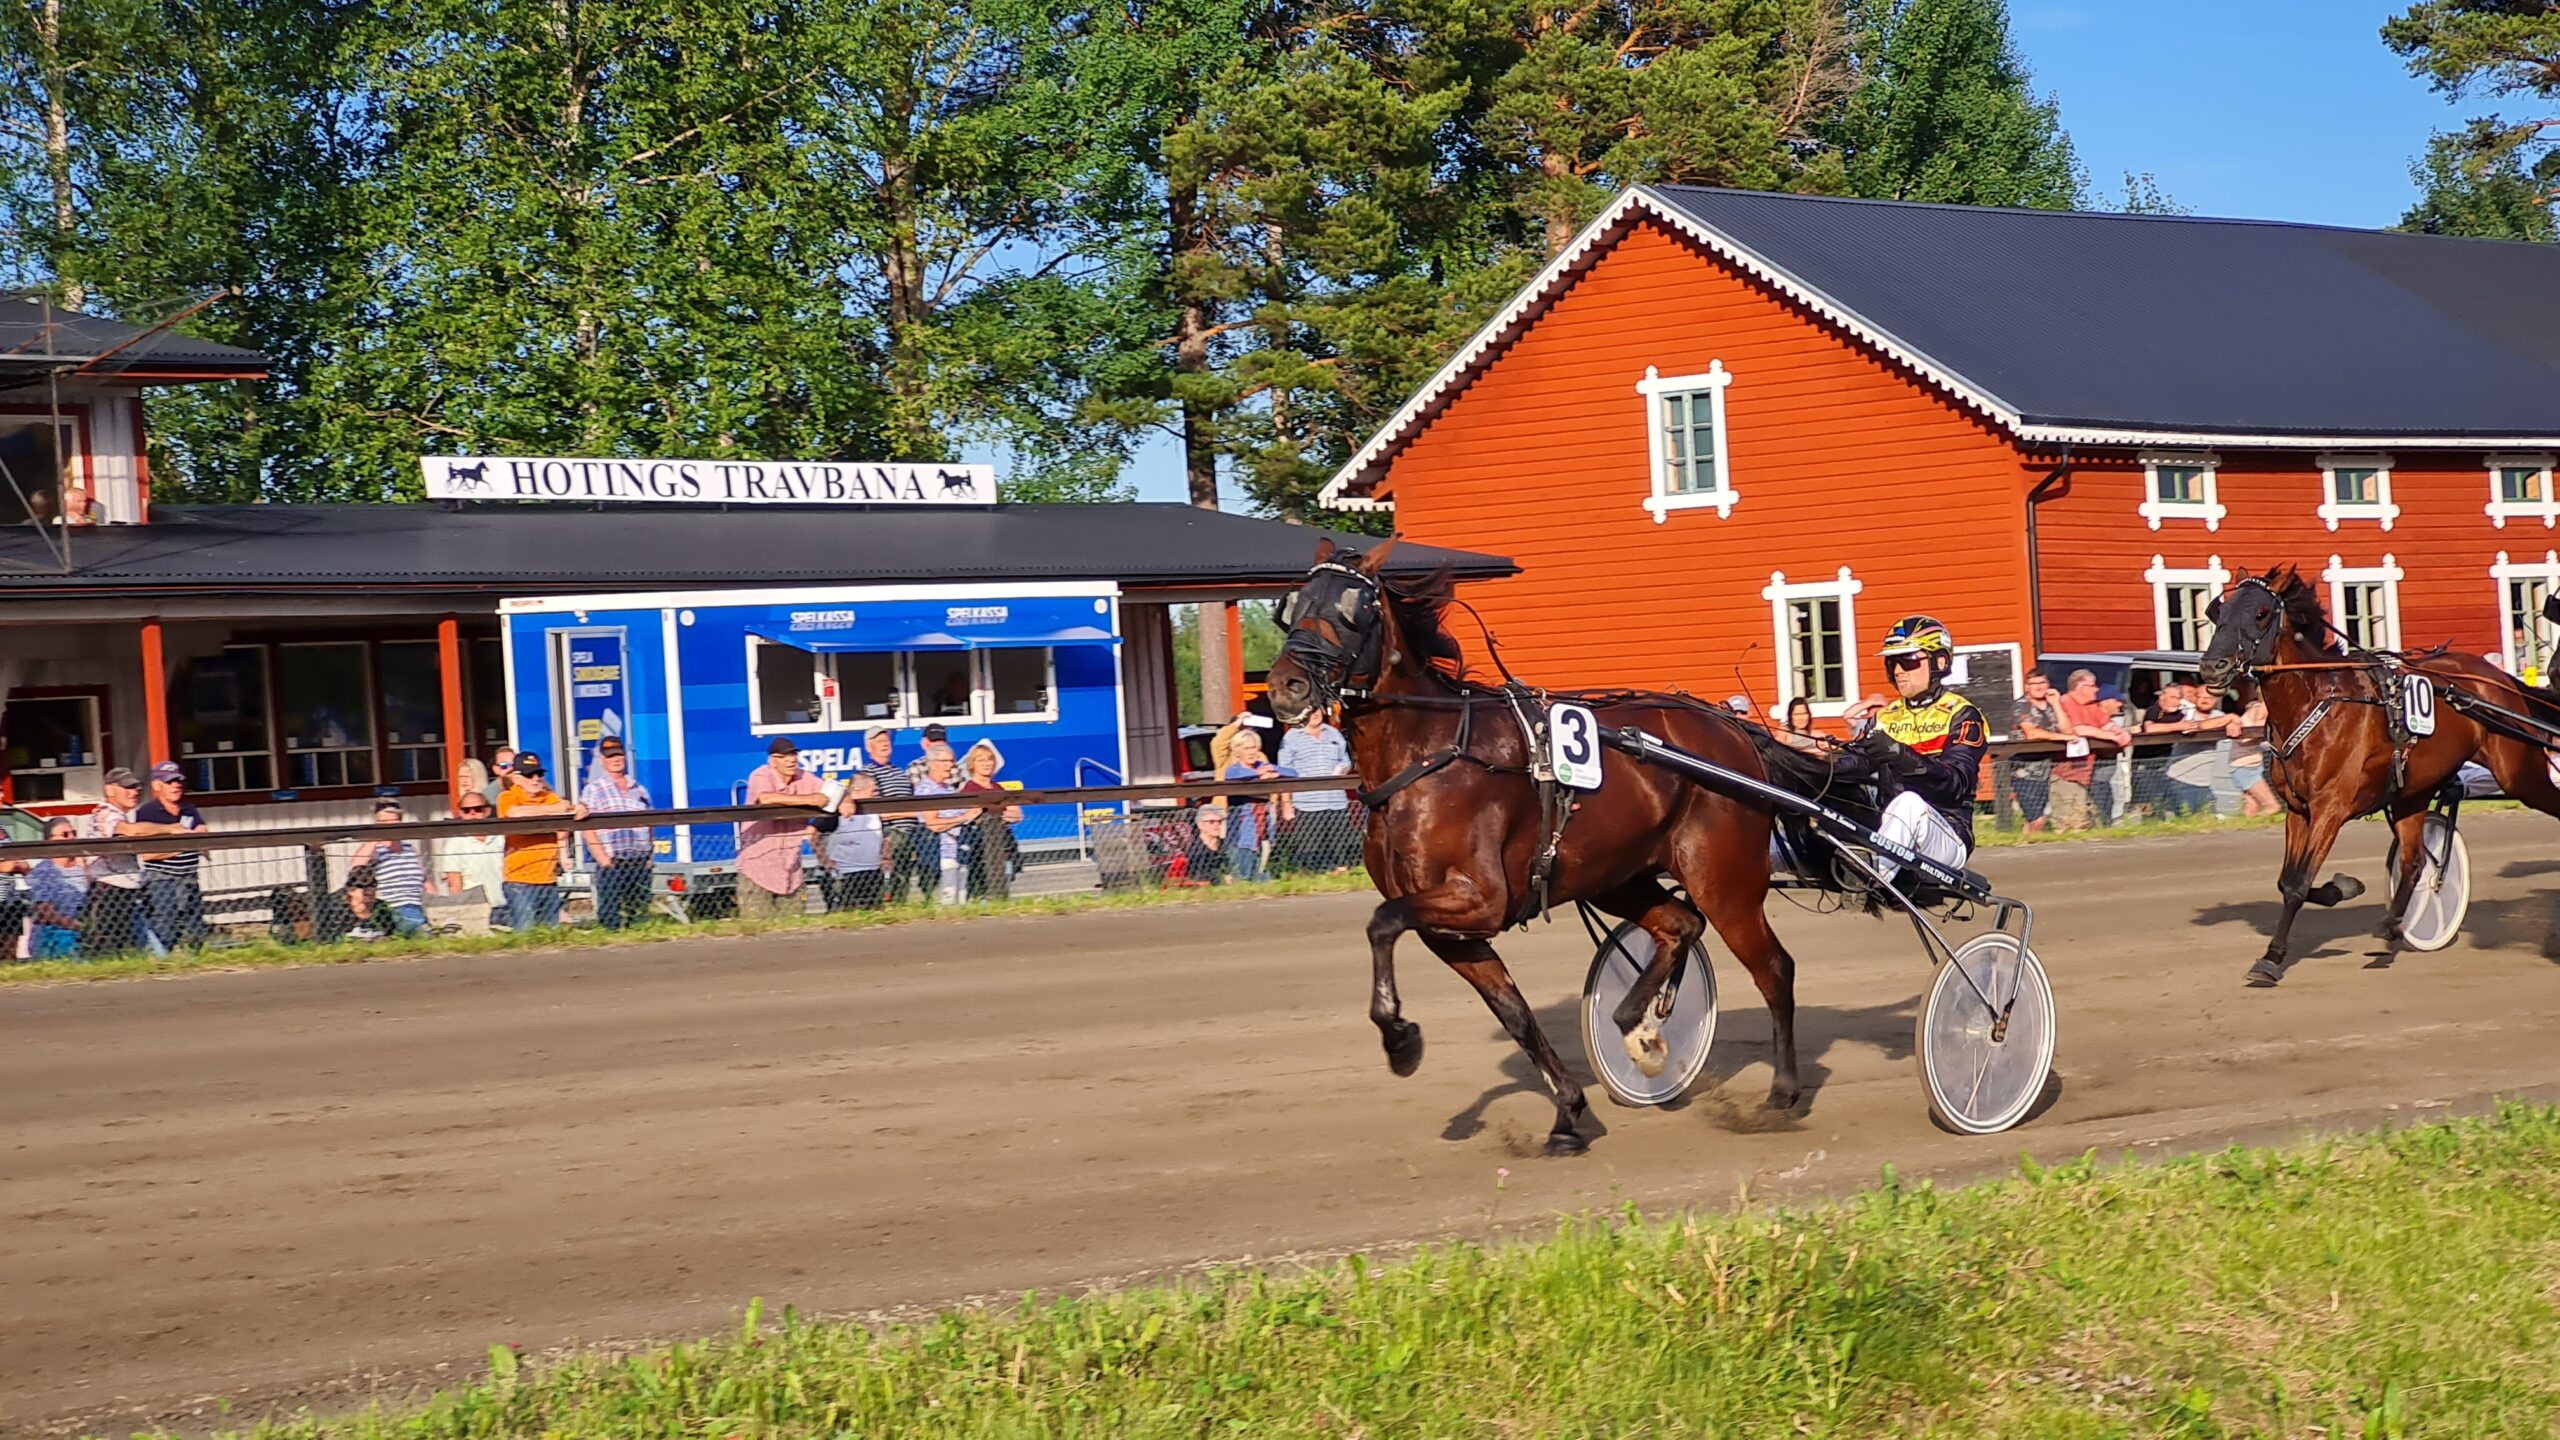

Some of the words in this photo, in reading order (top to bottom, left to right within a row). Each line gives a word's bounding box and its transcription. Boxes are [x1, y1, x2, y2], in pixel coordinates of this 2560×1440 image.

[508, 461, 701, 498] HOTINGS
[714, 465, 927, 500] TRAVBANA
[790, 610, 855, 623] SPELKASSA
[946, 606, 1008, 618] SPELKASSA
[2404, 676, 2432, 718] 10
[1561, 709, 1590, 765] 3
[797, 747, 863, 773] SPELA
[1869, 831, 1916, 863] CUSTOM
[1920, 861, 1955, 885] MULTIFLEX
